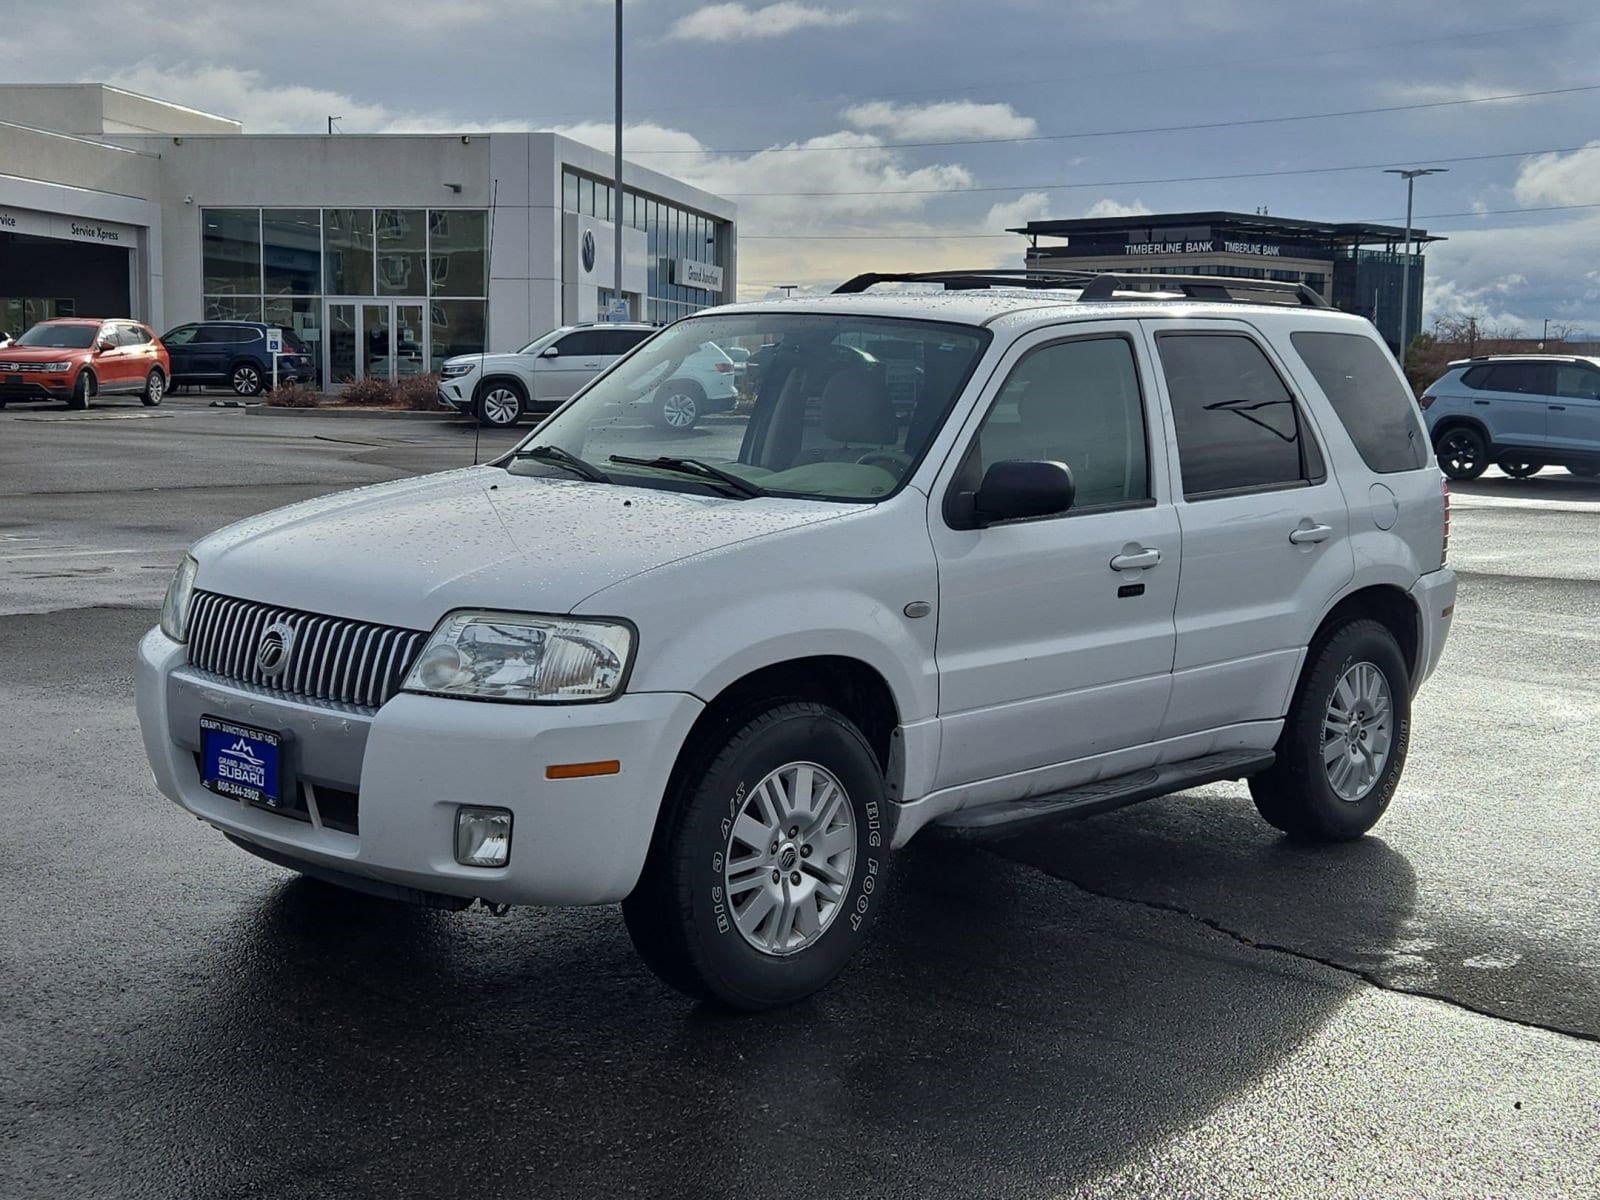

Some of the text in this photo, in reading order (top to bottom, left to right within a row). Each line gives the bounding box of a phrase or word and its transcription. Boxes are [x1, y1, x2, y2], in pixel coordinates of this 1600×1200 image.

[71, 222, 119, 241] Service Xpress
[1124, 241, 1214, 255] TIMBERLINE BANK
[1224, 241, 1280, 257] TIMBERLINE BANK
[688, 265, 702, 282] Grand
[218, 757, 238, 768] GRAND
[218, 765, 264, 787] SUBARU
[712, 886, 730, 934] BIG
[721, 782, 746, 840] A/S
[850, 801, 881, 931] BIG FOOT
